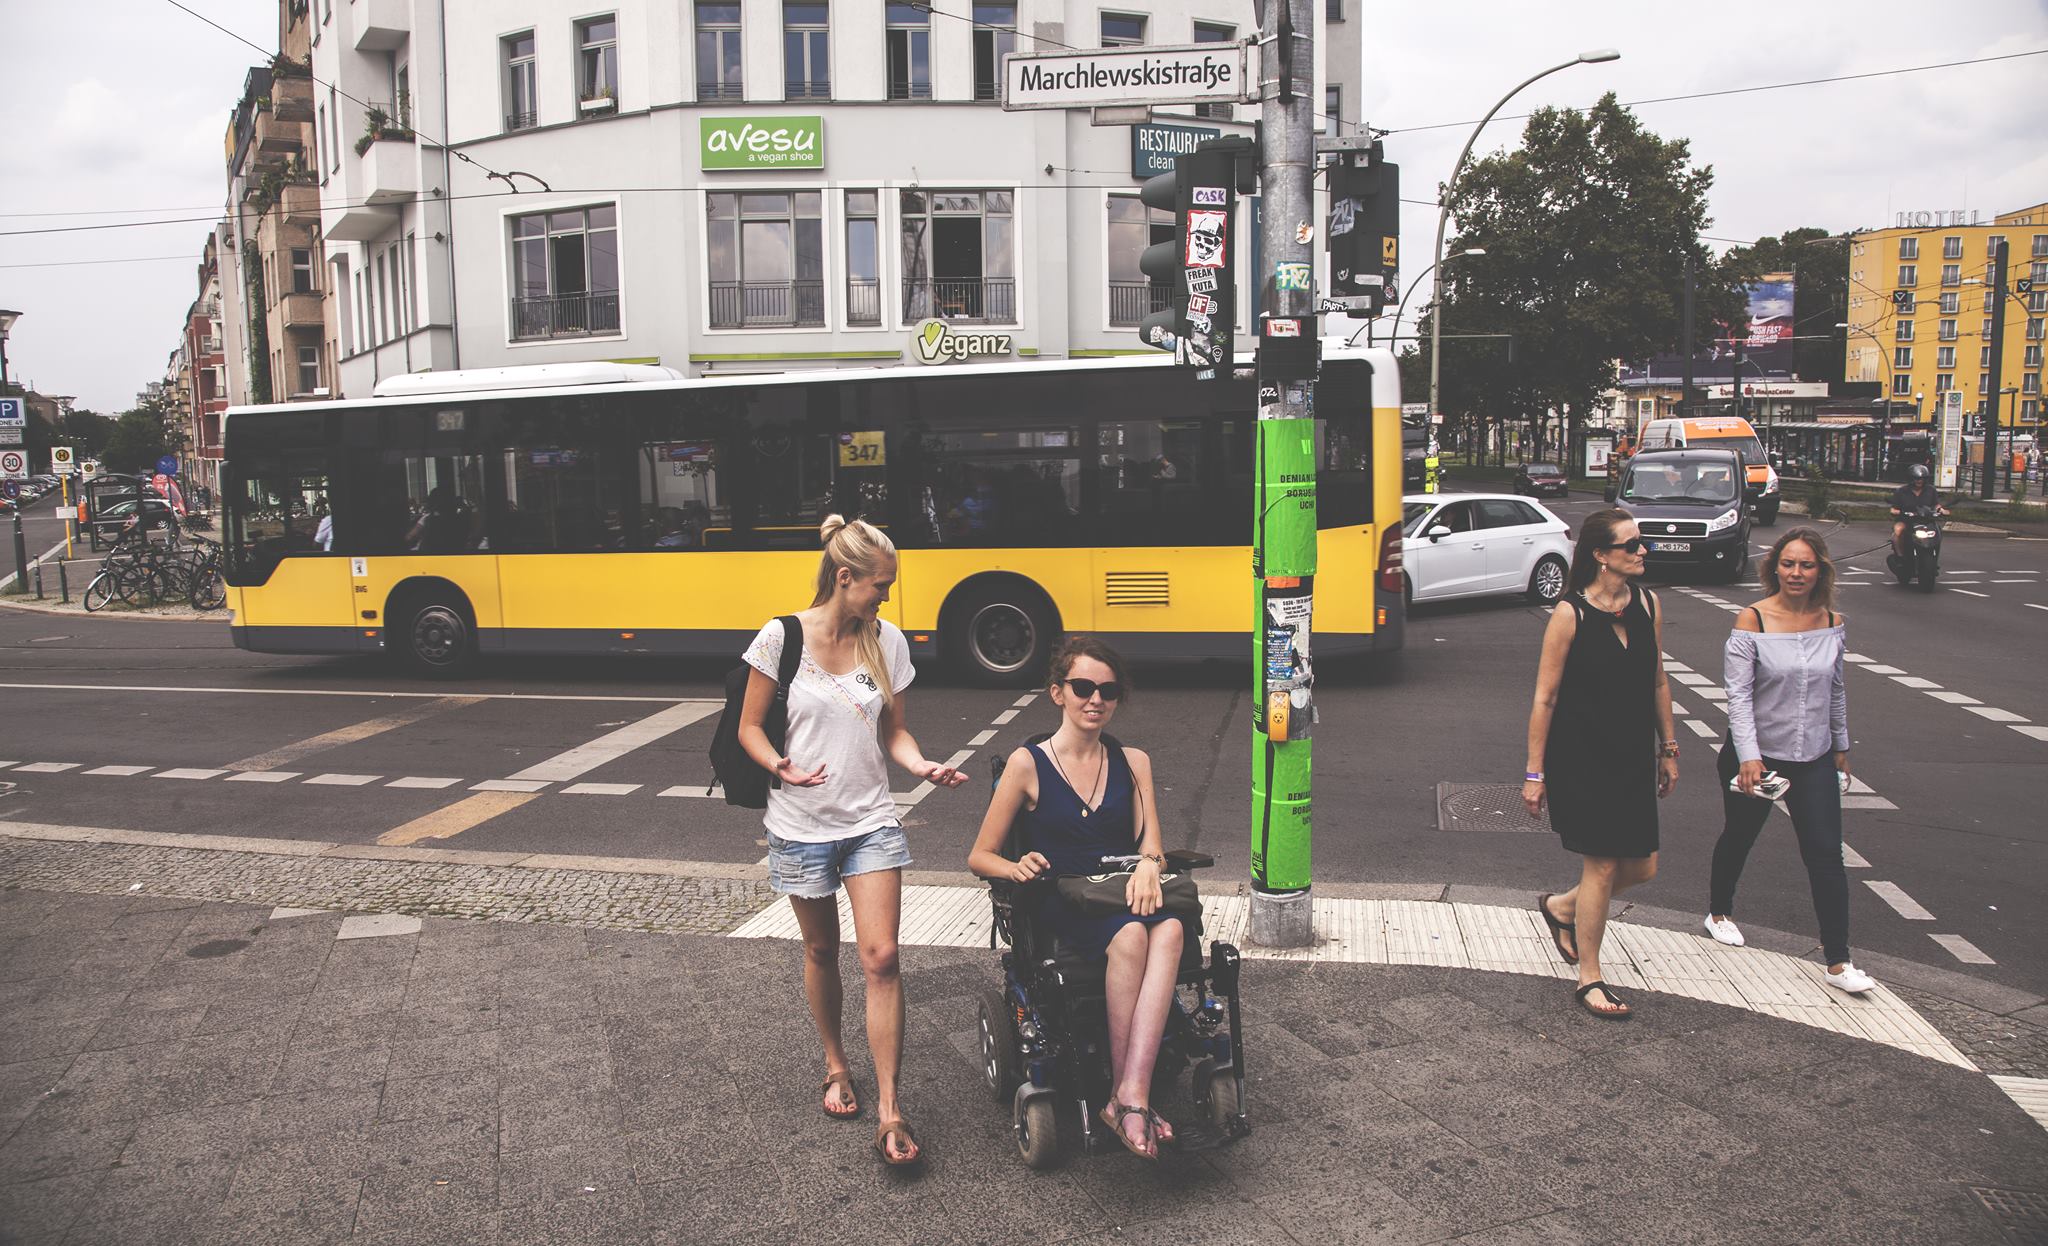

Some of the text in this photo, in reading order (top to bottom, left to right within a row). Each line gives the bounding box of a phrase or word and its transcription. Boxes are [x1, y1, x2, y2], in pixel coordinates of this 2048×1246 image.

[1020, 56, 1231, 91] Marchlewskistraße
[707, 123, 815, 152] avesu
[748, 151, 814, 164] a vegan shoe
[1148, 151, 1175, 170] clean
[1896, 209, 1979, 228] HOTEL
[1188, 267, 1213, 281] FREAK
[1192, 280, 1214, 292] KUTA
[918, 324, 1011, 360] Veganz
[1, 402, 13, 417] P
[847, 444, 879, 461] 347
[6, 457, 18, 468] 30
